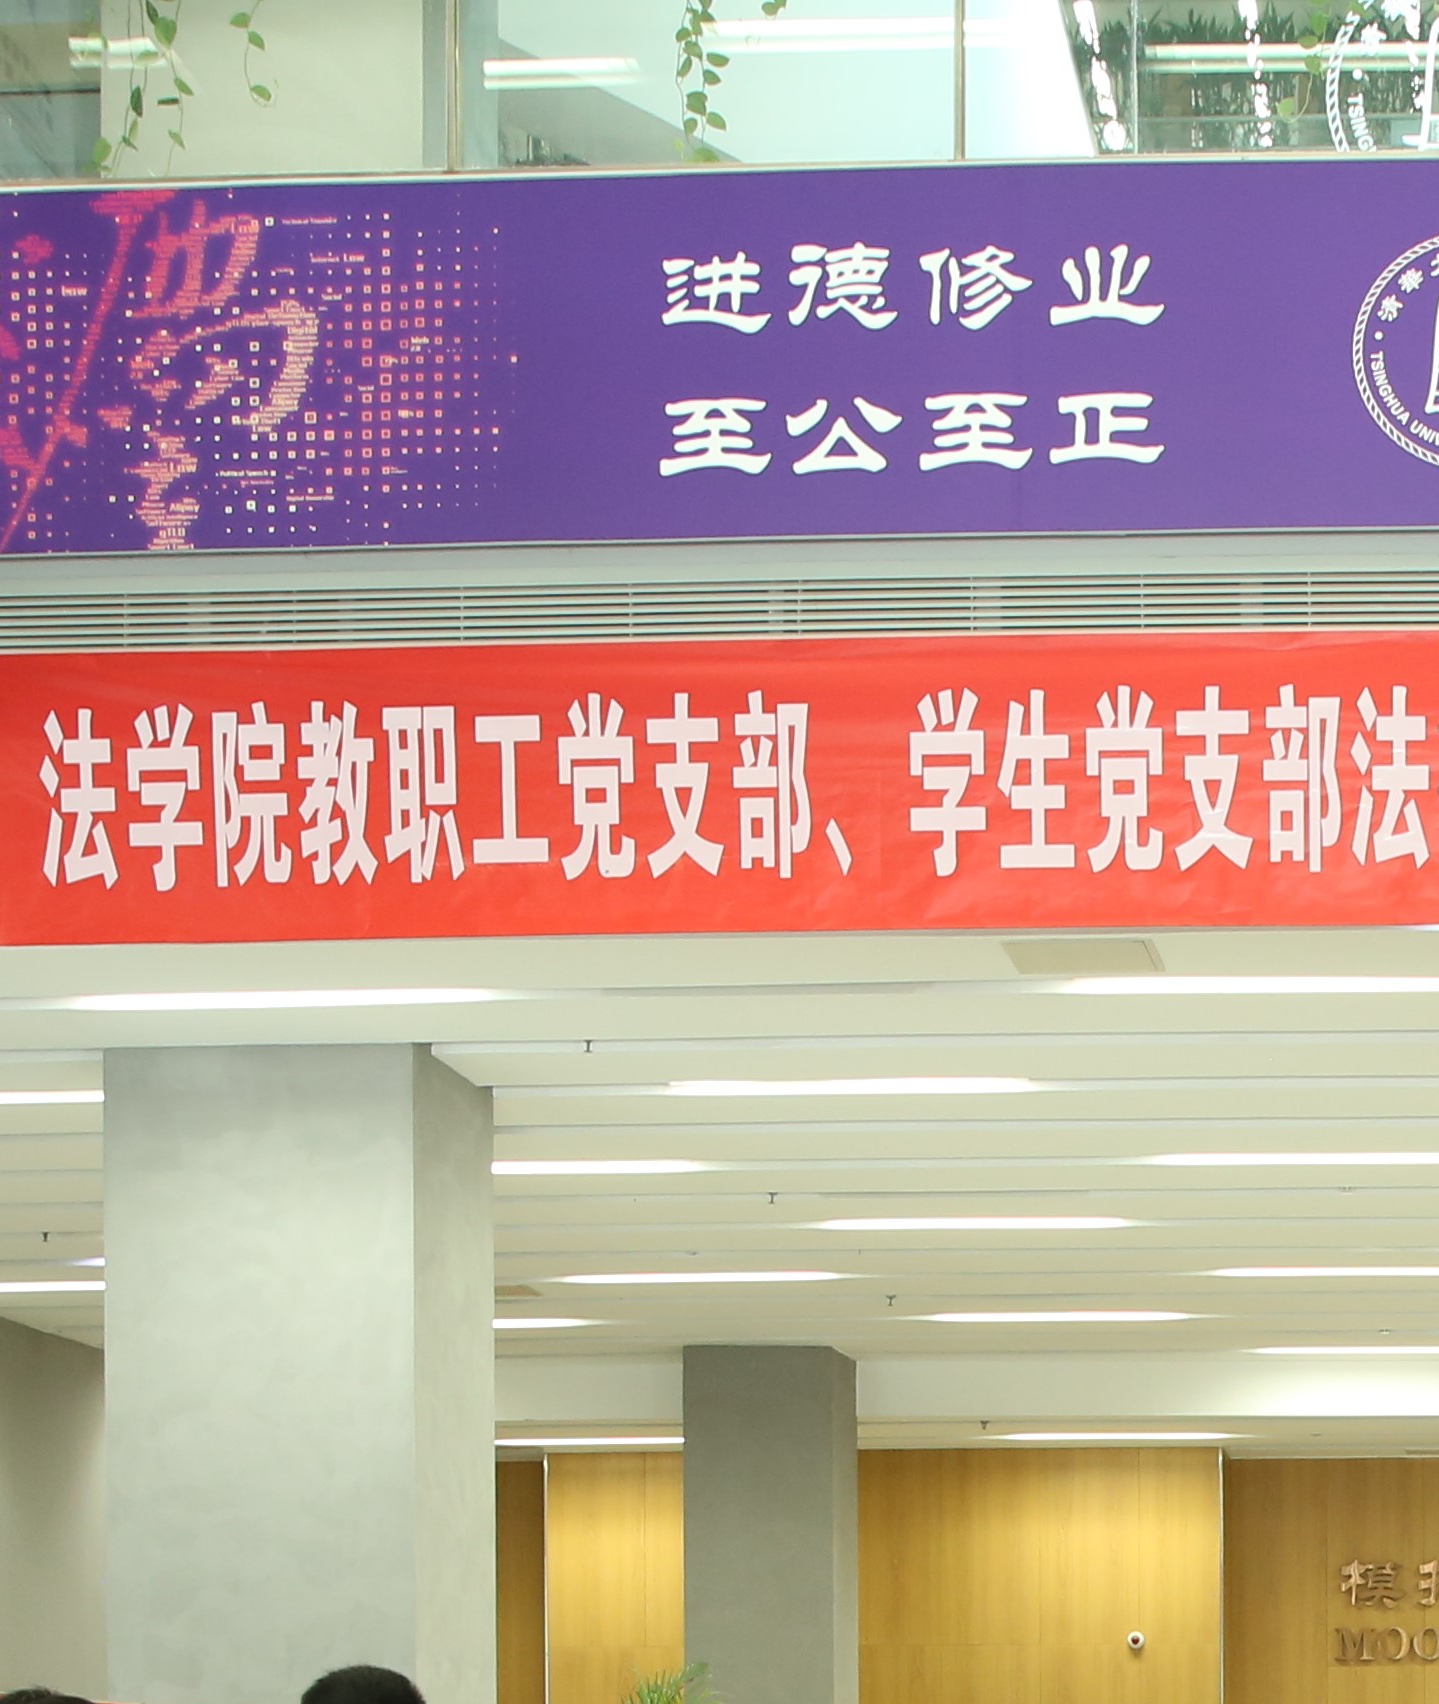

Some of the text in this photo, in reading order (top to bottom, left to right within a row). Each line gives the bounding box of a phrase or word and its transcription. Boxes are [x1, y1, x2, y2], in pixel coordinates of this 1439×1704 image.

[662, 241, 1166, 334] 进德修业
[1370, 350, 1409, 427] TSINGHUA
[659, 391, 1166, 477] 至公至正
